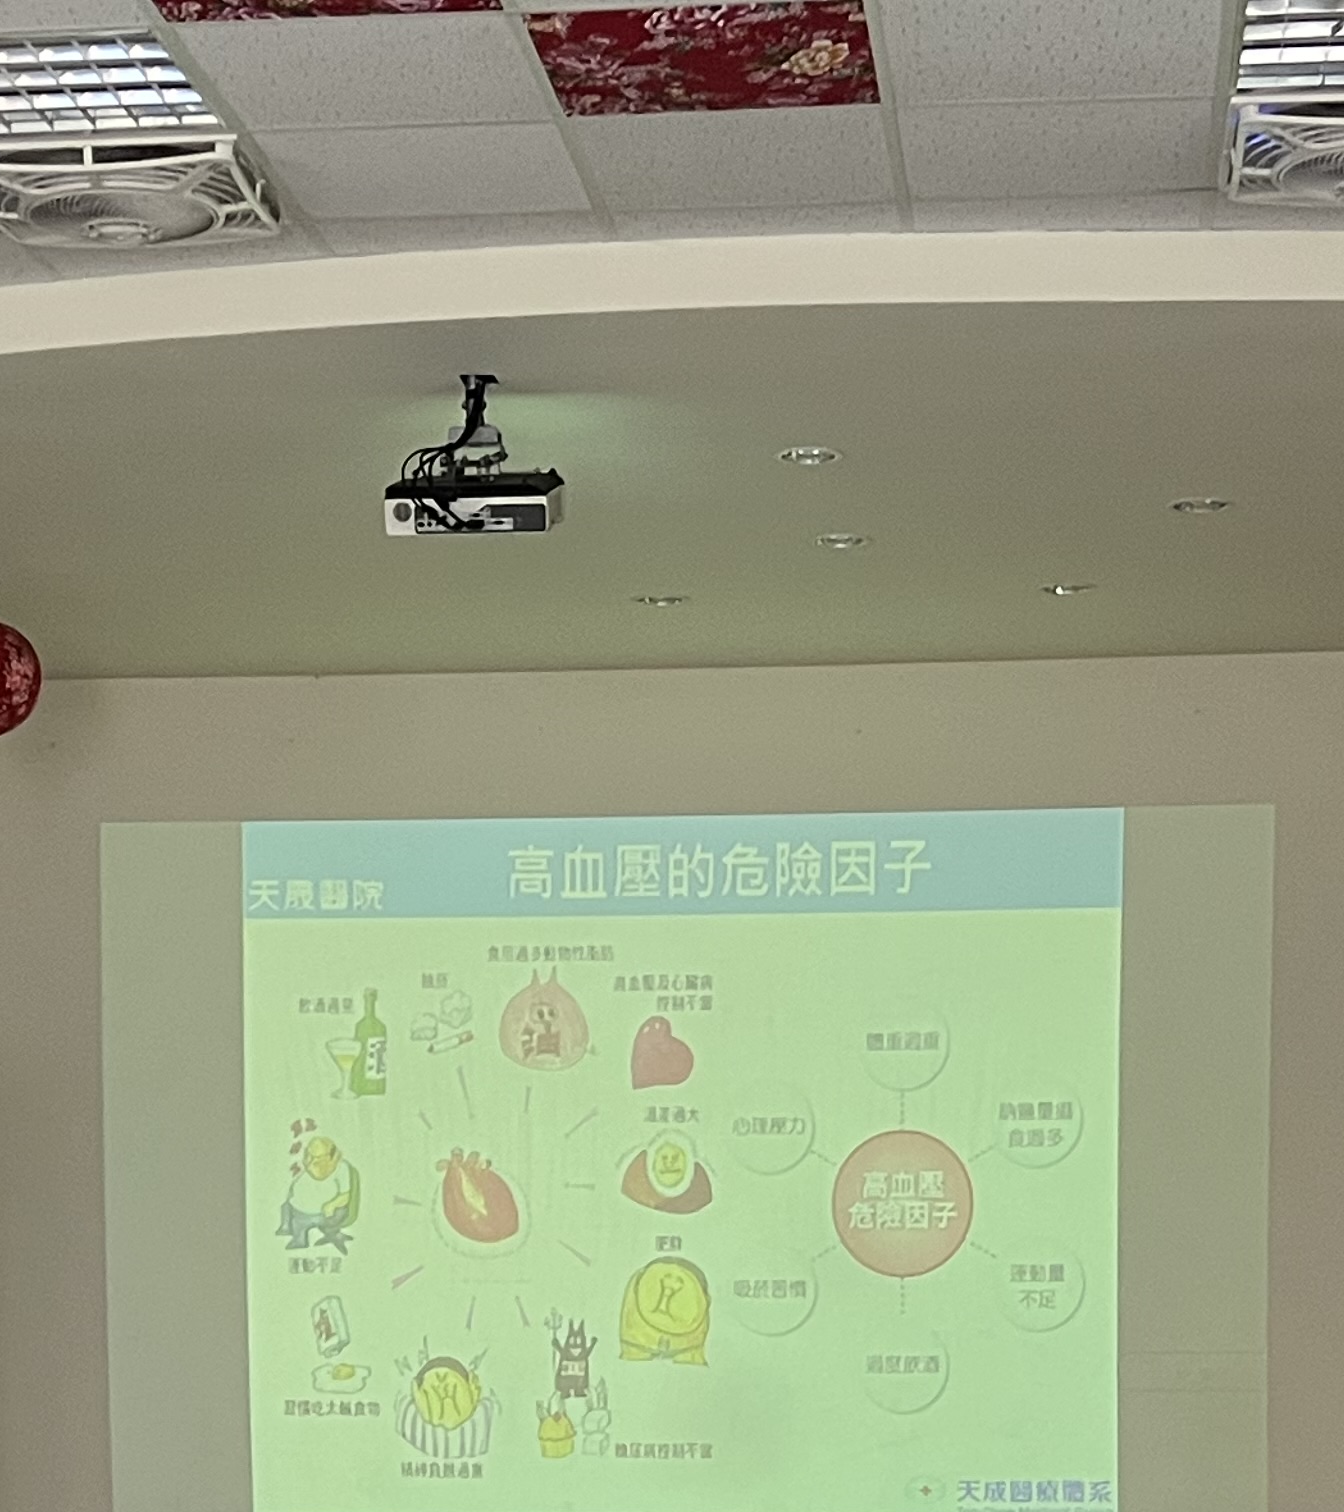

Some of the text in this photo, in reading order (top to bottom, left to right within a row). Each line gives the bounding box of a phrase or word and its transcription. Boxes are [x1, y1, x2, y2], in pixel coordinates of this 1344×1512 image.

[507, 838, 933, 899] 高血壓的危險因子
[248, 879, 385, 912] 天晟醫院
[866, 1032, 940, 1052] 體重過重
[732, 1117, 806, 1137] 心理壓力
[862, 1171, 946, 1199] 高血壓
[848, 1203, 958, 1231] 危險因子
[1010, 1263, 1065, 1284] 運動量
[1018, 1290, 1057, 1310] 不足
[957, 1480, 1113, 1503] 天成醫療體系
